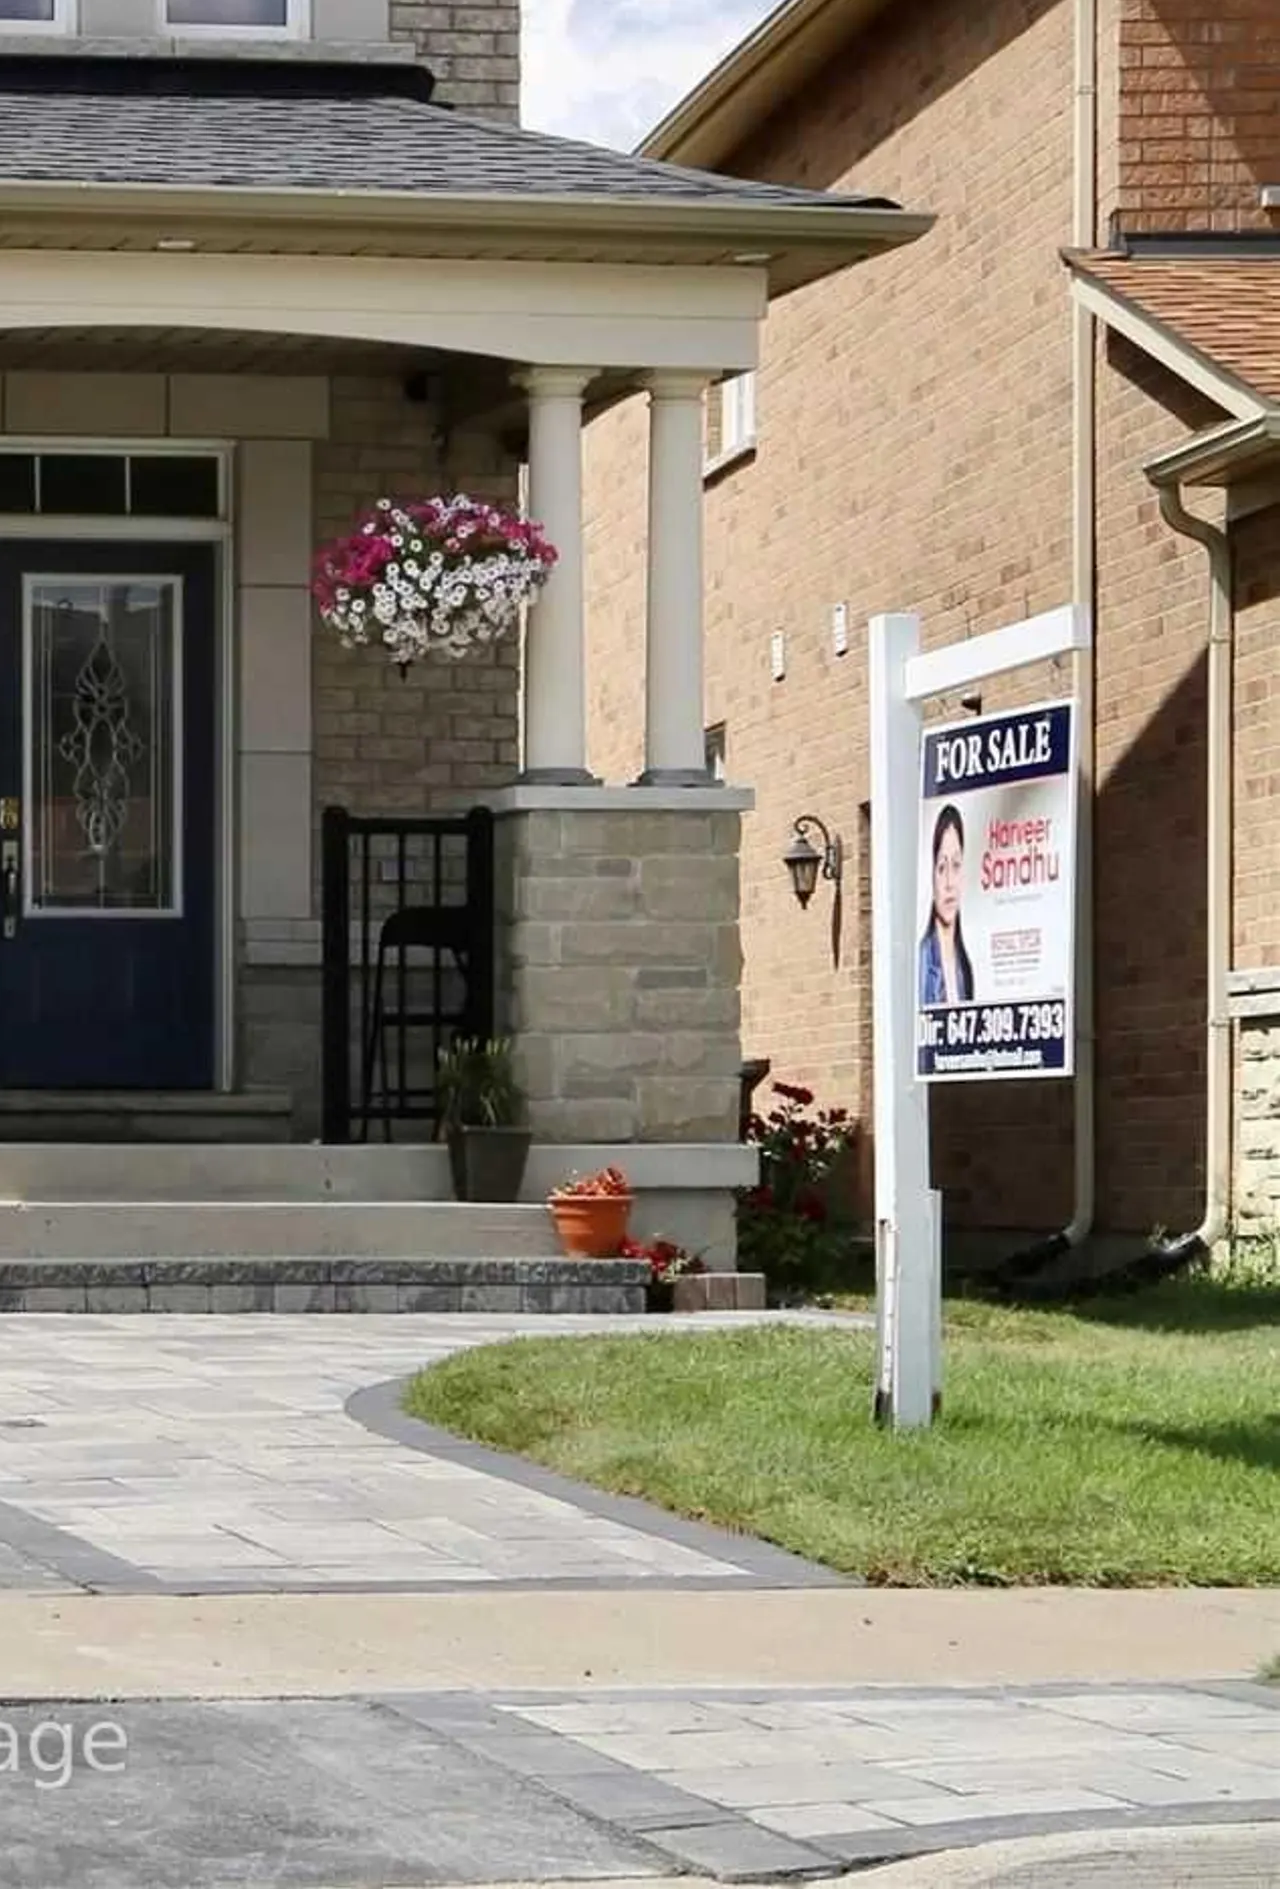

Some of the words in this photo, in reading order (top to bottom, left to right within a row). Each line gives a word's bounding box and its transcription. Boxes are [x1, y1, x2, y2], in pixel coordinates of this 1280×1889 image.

[934, 734, 985, 783] FOR
[986, 719, 1052, 772] SALE
[981, 844, 1060, 891] Sandhu
[947, 1003, 1064, 1045] 647.309.7393
